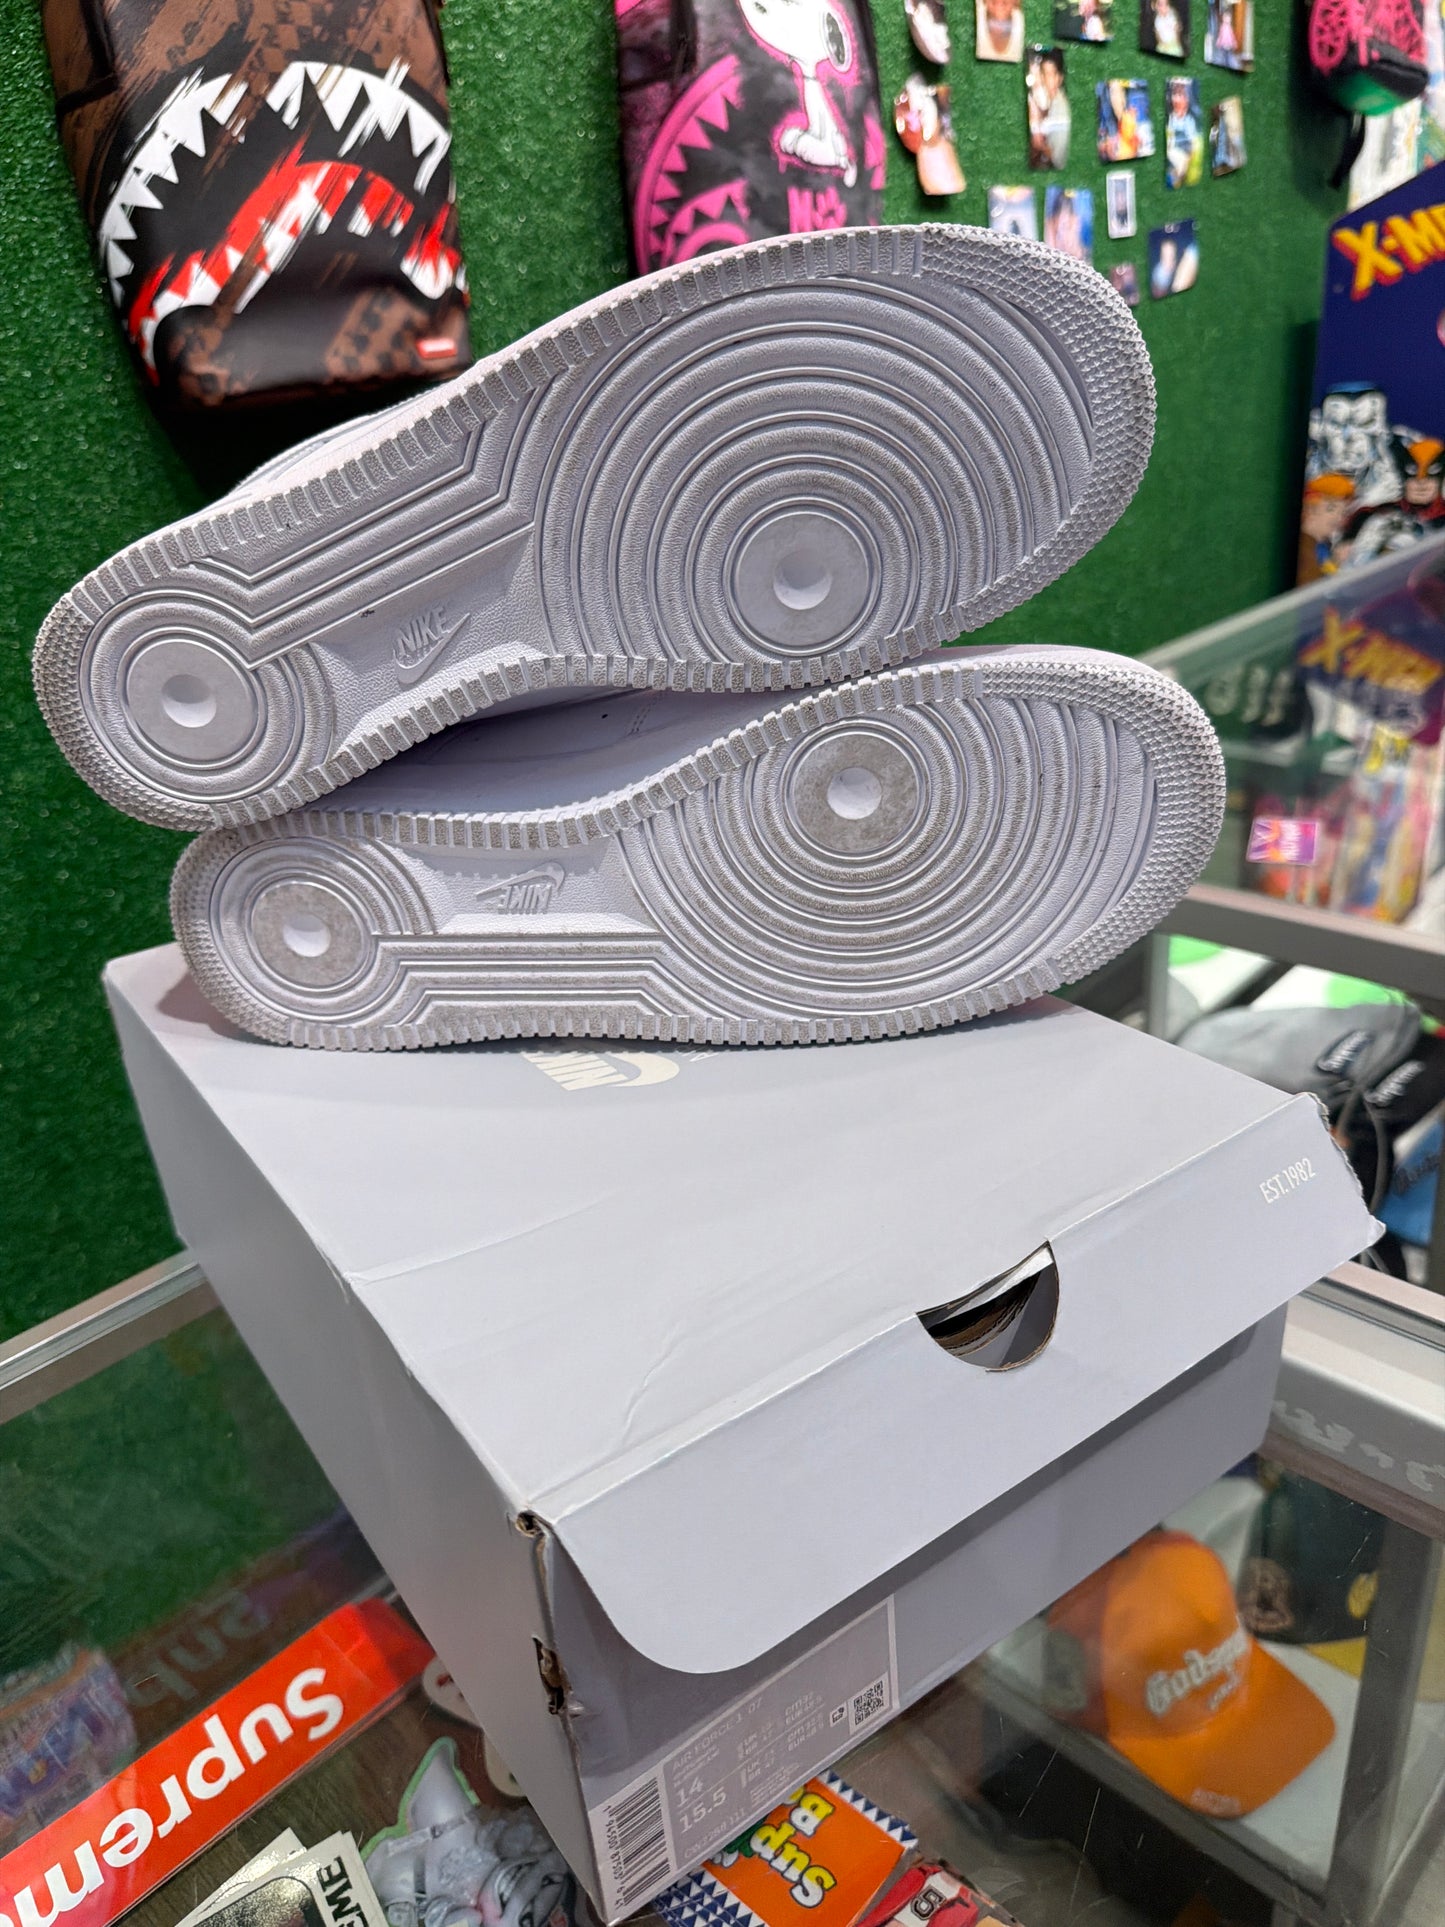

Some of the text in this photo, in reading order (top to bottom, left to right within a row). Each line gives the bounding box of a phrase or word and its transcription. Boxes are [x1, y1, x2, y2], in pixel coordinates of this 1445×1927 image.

[398, 604, 451, 653] NIKE
[498, 884, 554, 914] NIKE
[521, 1050, 629, 1091] NIK
[1259, 1157, 1316, 1204] EST.1982
[672, 1753, 693, 1770] AIR
[0, 1667, 345, 1927] Suprem
[676, 1776, 704, 1808] 14
[678, 1785, 727, 1834] 15.5
[750, 1821, 838, 1909] Sup
